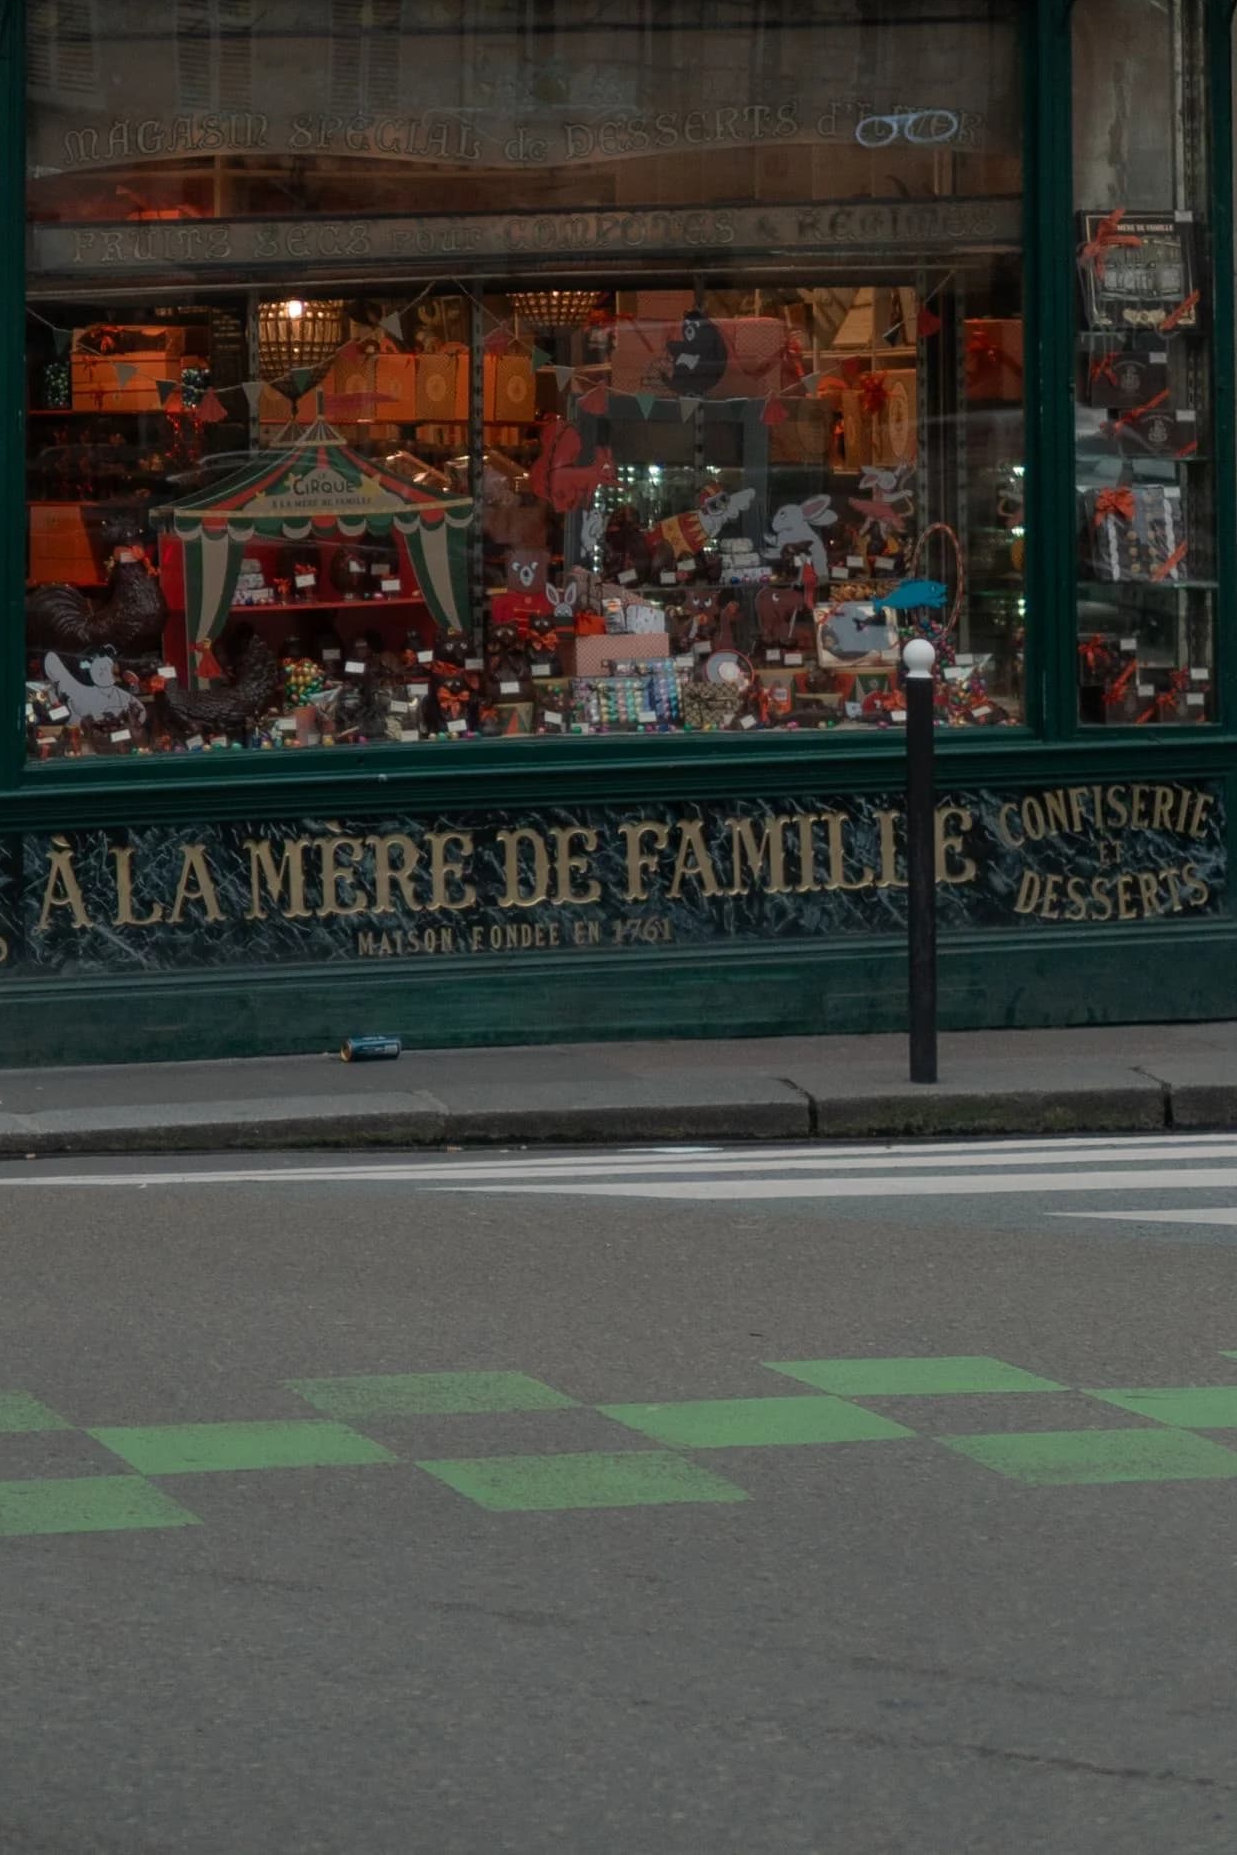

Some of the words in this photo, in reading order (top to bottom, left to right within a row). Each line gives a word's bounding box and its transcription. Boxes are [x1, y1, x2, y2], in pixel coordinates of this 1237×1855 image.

[998, 783, 1214, 850] CONFISERIE
[38, 835, 93, 931] À
[109, 844, 226, 927] LA
[242, 820, 478, 920] MÈRE
[495, 825, 603, 908] DE
[618, 806, 978, 903] FAMILLE
[1099, 839, 1123, 864] ET
[1014, 862, 1209, 923] DESSERTS
[357, 926, 453, 957] MAISON
[574, 921, 601, 945] EN
